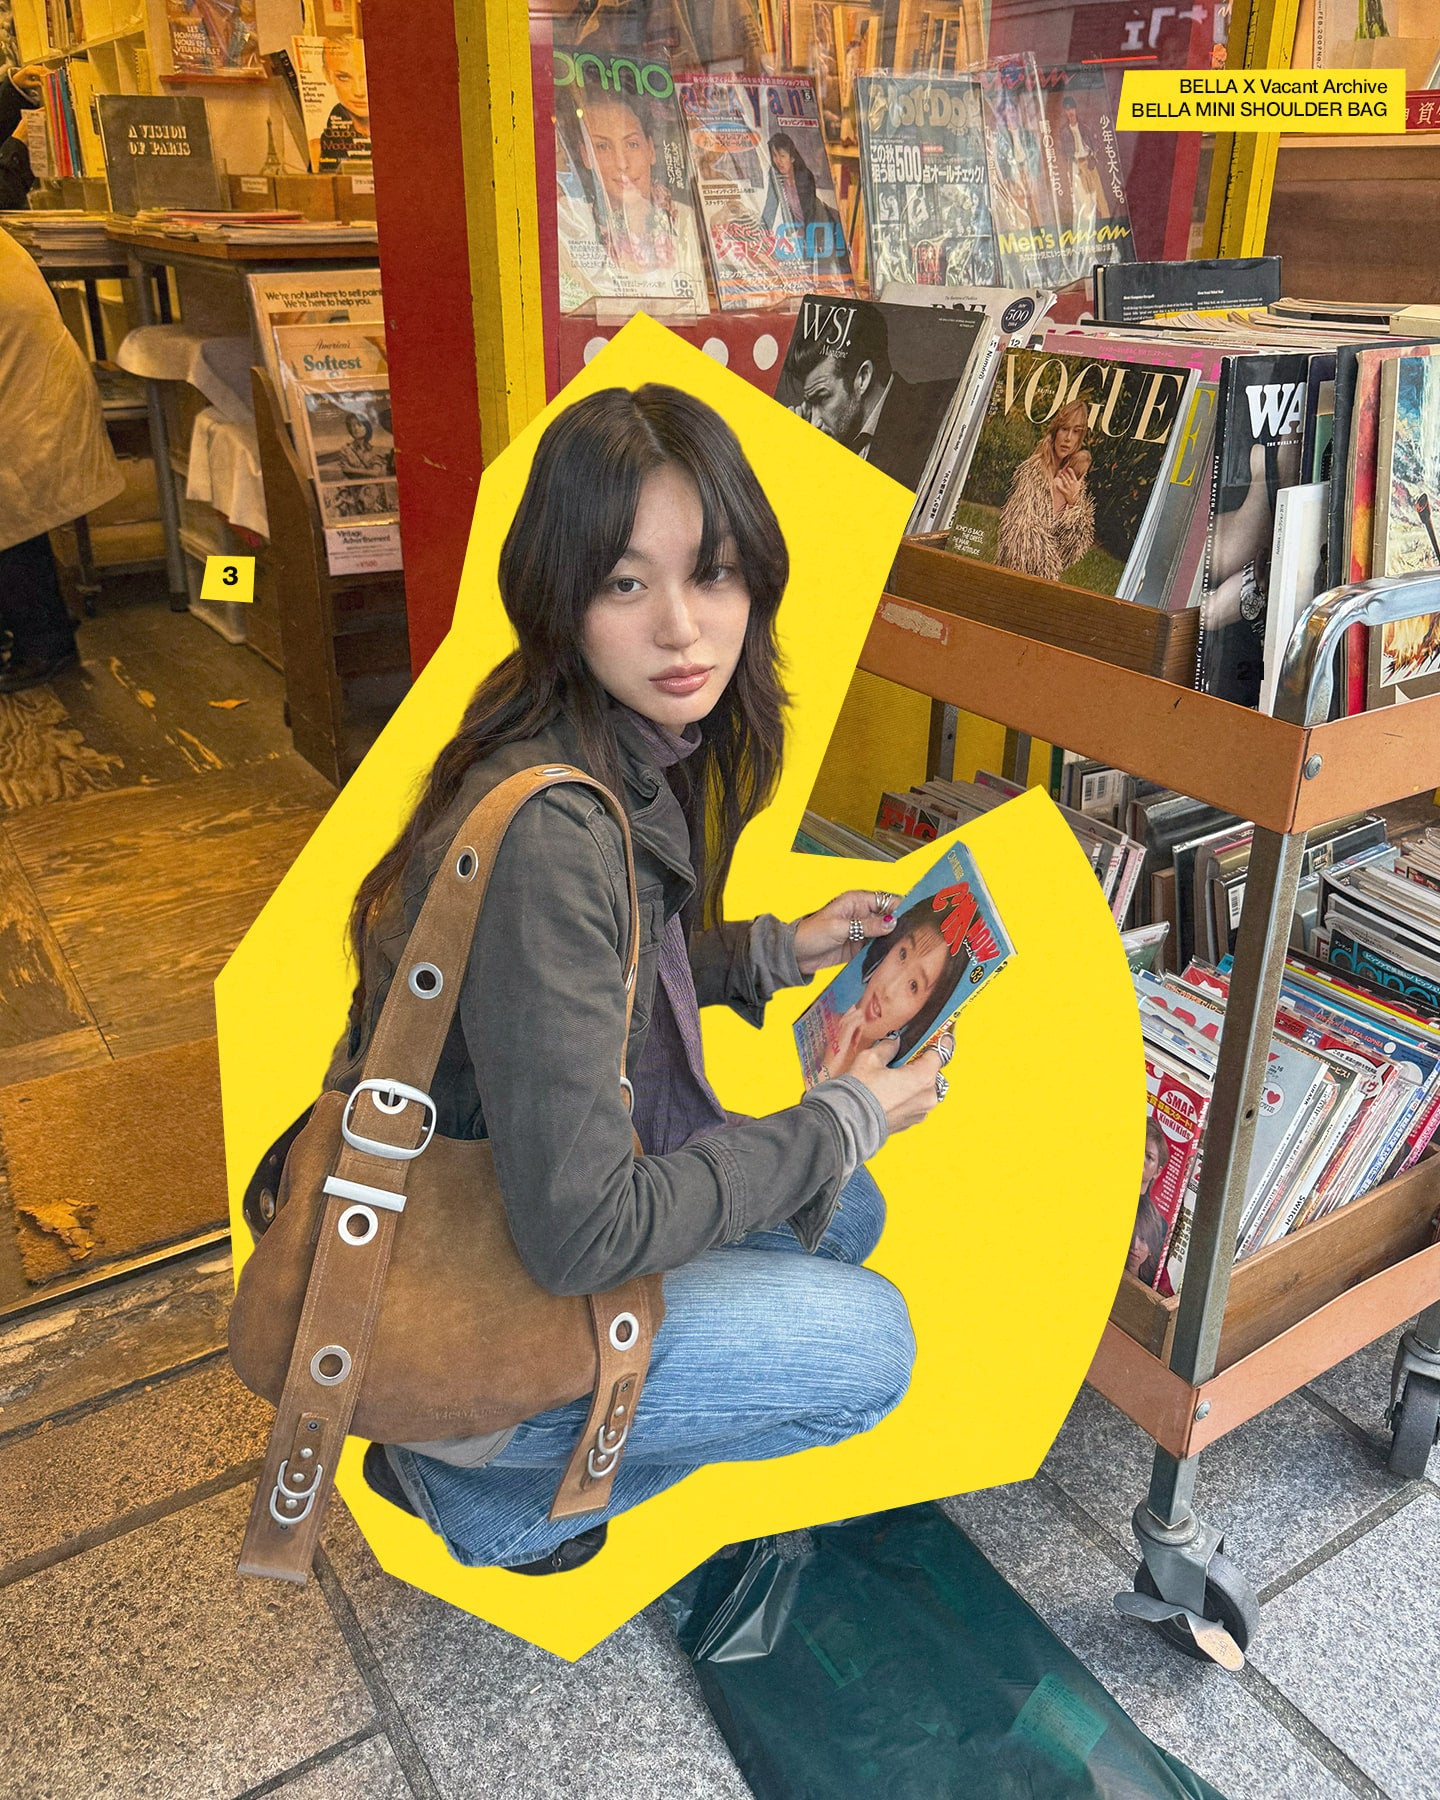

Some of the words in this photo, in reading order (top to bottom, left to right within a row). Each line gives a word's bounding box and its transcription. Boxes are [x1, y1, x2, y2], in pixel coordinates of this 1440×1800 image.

[128, 124, 138, 138] A
[139, 125, 187, 139] VISION
[129, 141, 145, 155] OF
[149, 142, 191, 156] PARIS
[895, 145, 921, 183] 500
[998, 227, 1055, 256] Men's
[265, 292, 289, 301] We're
[291, 291, 304, 300] not
[305, 291, 319, 300] just
[320, 290, 337, 298] here
[348, 289, 361, 297] sell
[283, 300, 307, 309] We're
[308, 299, 326, 308] here
[327, 299, 335, 307] to
[336, 299, 353, 309] help
[1005, 309, 1030, 321] 500
[1010, 339, 1020, 347] 12
[303, 354, 363, 371] Softest
[1004, 354, 1185, 444] VOGUE
[1210, 483, 1218, 508] WATCH
[971, 967, 983, 983] 33
[1166, 1091, 1195, 1117] SMAP
[1283, 1194, 1306, 1226] SWITCH
